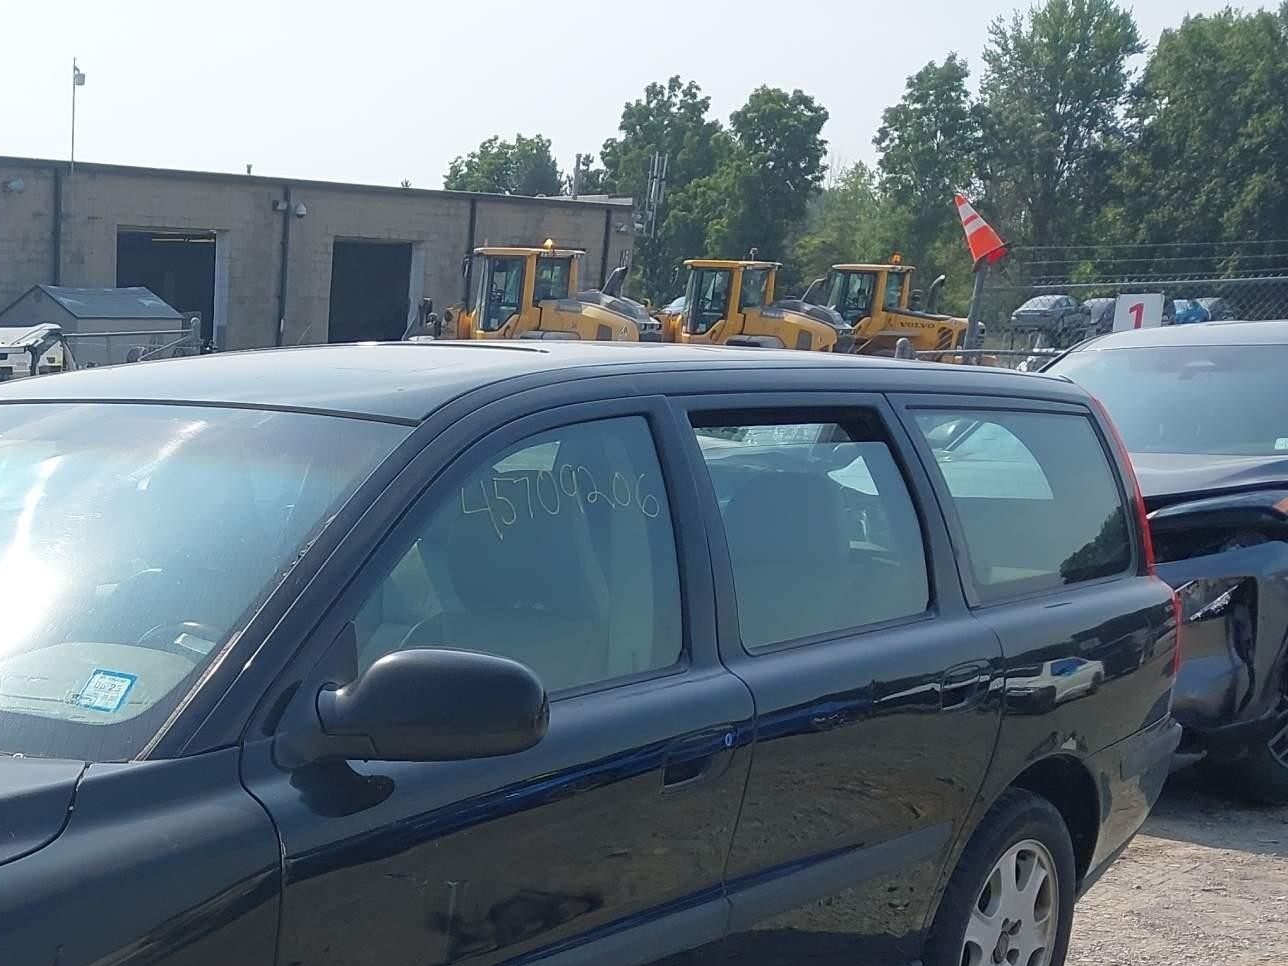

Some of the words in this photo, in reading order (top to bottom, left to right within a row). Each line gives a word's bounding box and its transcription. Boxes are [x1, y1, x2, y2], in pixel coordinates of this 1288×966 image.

[899, 319, 935, 329] VOLVO
[1128, 302, 1145, 330] 1
[460, 464, 660, 540] 45709206
